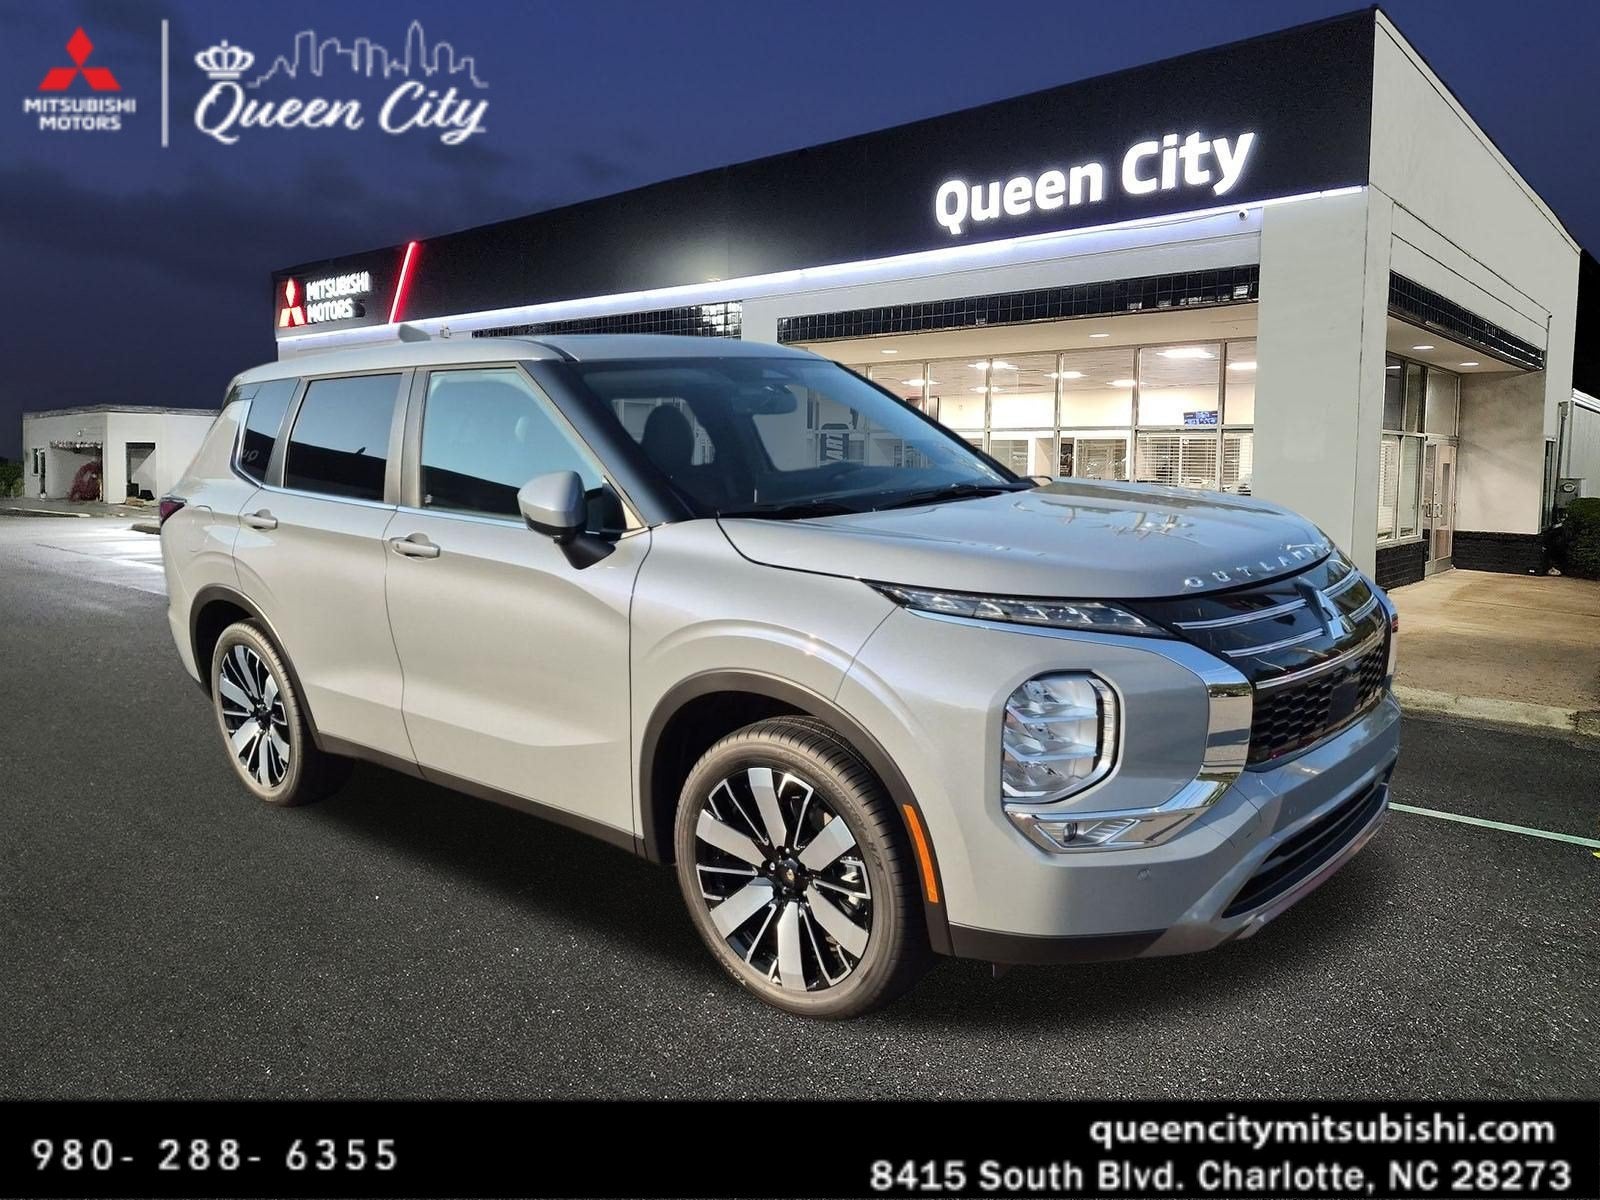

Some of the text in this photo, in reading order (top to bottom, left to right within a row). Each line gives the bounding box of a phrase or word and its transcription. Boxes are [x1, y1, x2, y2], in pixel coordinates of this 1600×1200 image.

[935, 131, 1256, 235] Queen City
[306, 270, 370, 301] MITSUBISHI
[306, 297, 354, 324] MOTORS
[1184, 543, 1330, 588] OUTLAN
